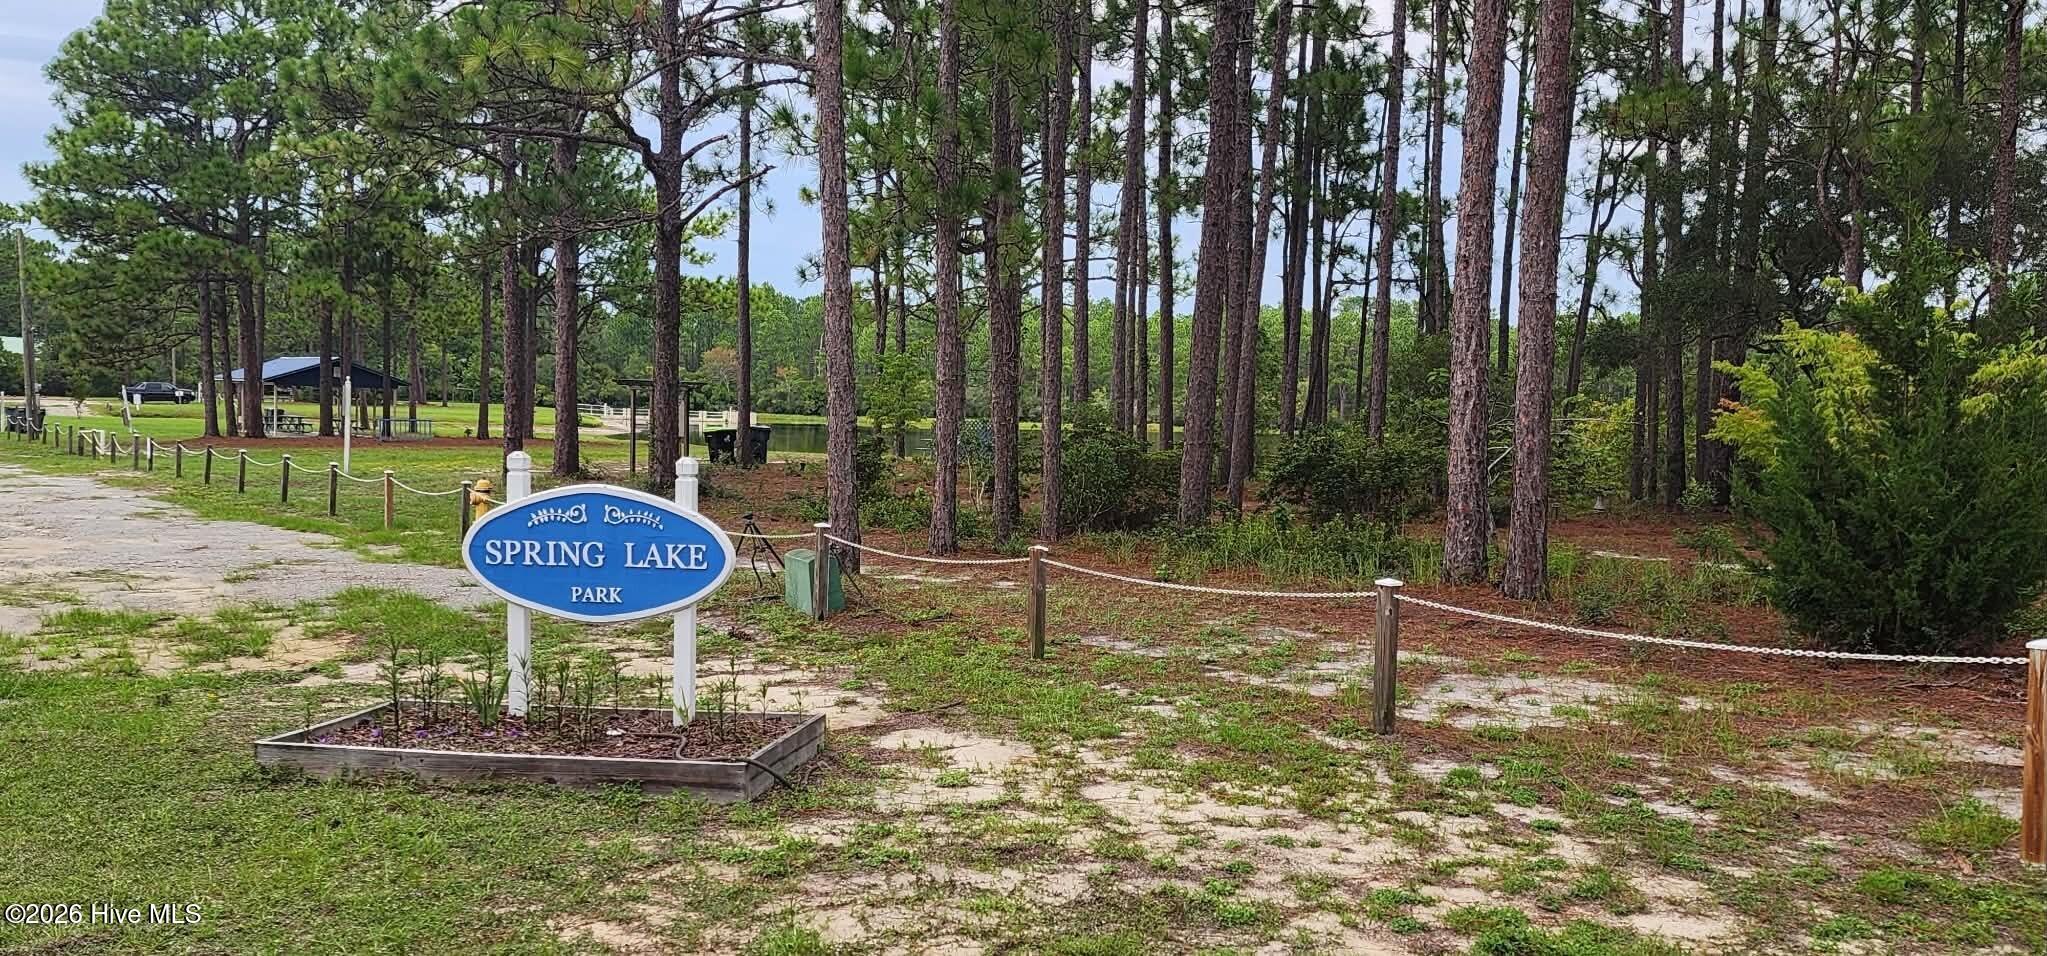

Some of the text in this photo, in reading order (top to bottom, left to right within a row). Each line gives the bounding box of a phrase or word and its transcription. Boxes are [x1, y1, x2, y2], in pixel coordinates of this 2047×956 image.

[485, 539, 708, 570] SPRING LAKE
[571, 586, 622, 603] PARK
